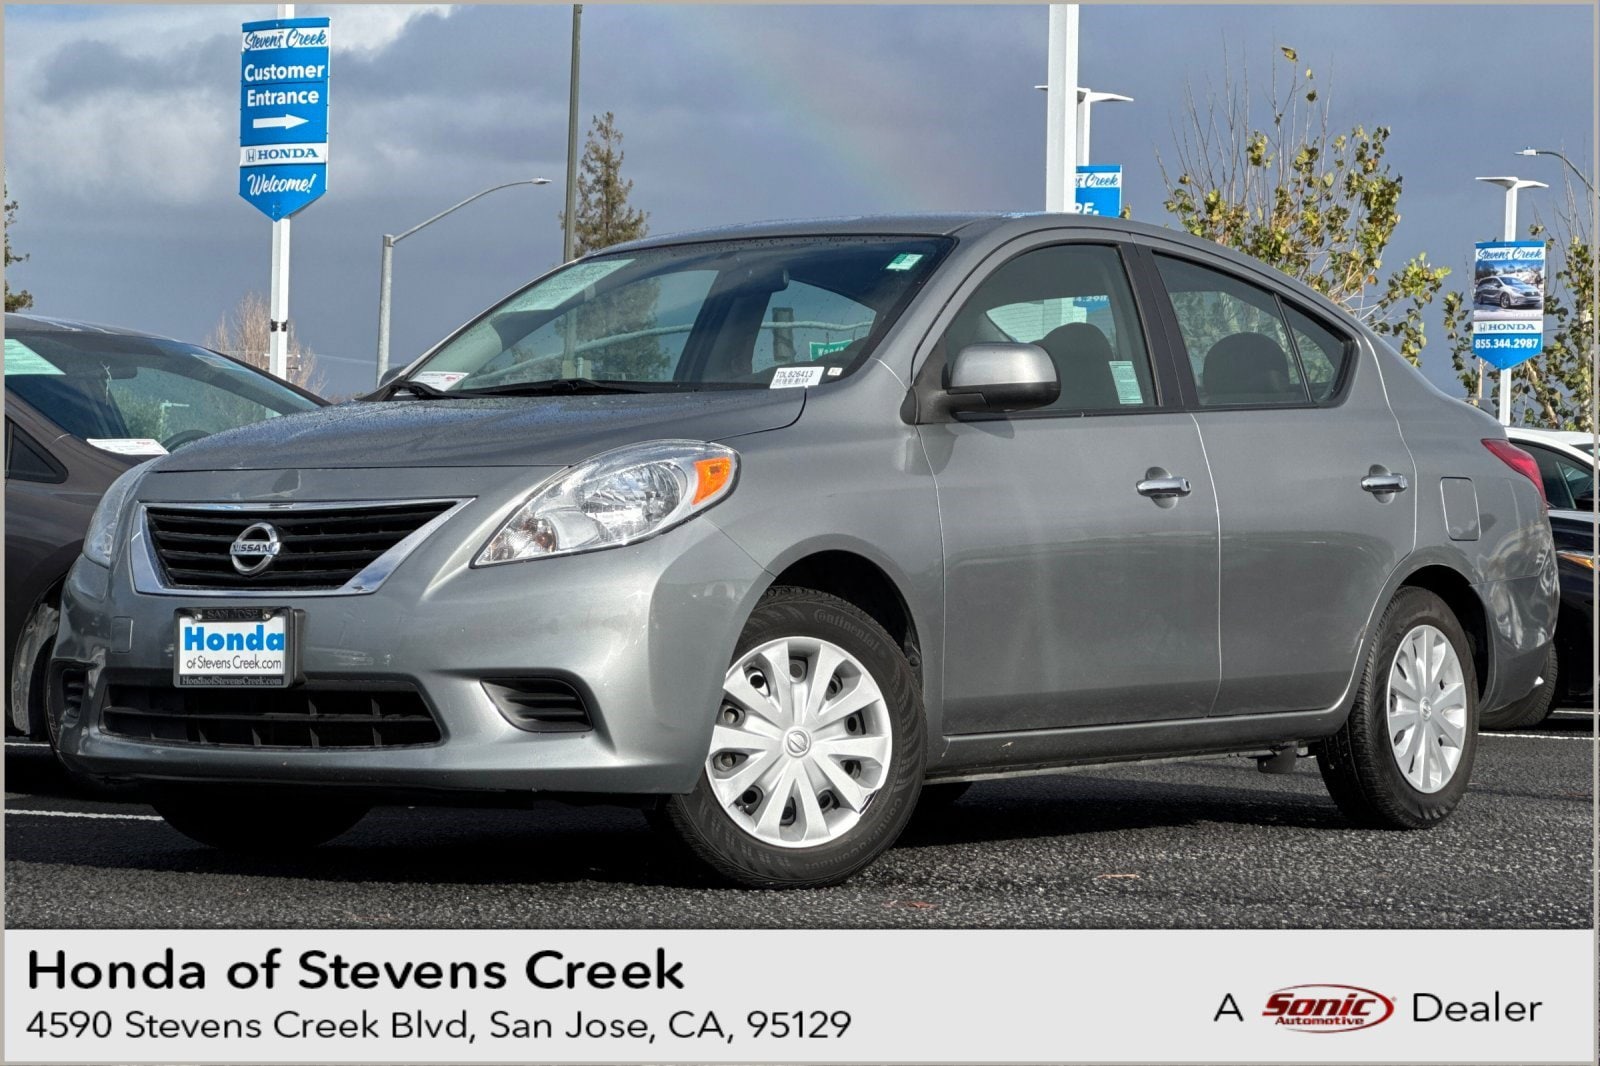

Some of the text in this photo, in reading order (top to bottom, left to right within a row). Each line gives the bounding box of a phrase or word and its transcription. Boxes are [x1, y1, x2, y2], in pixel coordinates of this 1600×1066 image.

[244, 27, 327, 51] Stevens Creek
[244, 63, 325, 82] Customer
[247, 89, 319, 107] Entrance
[257, 148, 319, 160] HONDA
[247, 173, 317, 196] Welcome!
[1084, 172, 1119, 189] Creek
[1477, 247, 1543, 260] Stevens Creek
[1488, 323, 1536, 331] HONDA
[1475, 338, 1539, 349] 855.344.2987
[232, 543, 274, 553] NISSAN
[184, 624, 285, 651] Honda
[186, 654, 282, 669] of Stevens Creek.com
